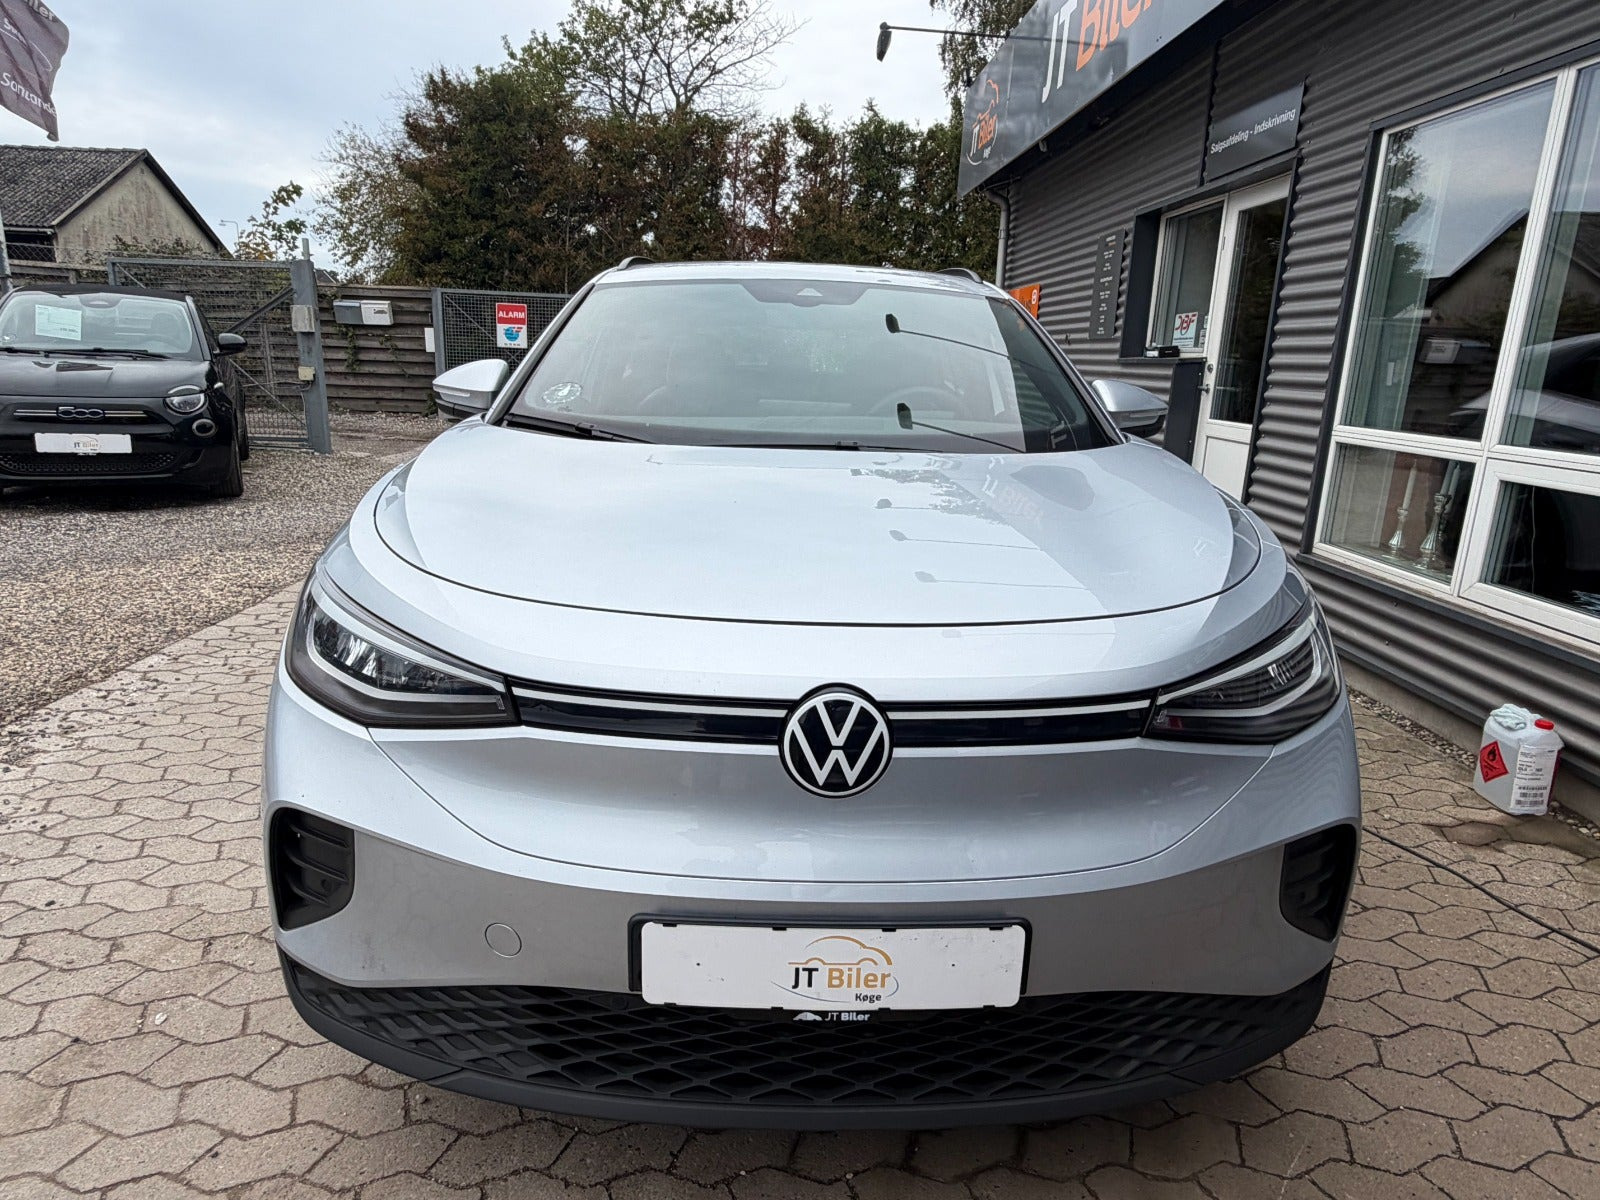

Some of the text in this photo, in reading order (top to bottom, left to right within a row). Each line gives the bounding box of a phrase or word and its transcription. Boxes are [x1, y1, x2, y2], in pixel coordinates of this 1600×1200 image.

[25, 0, 57, 21] iler
[1041, 0, 1152, 104] JT Bil
[1210, 130, 1250, 154] Salgsafdeling
[1254, 109, 1296, 135] Indskrivning
[498, 310, 526, 319] ALARM
[58, 406, 104, 418] 500
[784, 693, 890, 797] VW
[792, 967, 891, 989] JT Biler
[855, 992, 882, 1004] Køge
[824, 1012, 870, 1021] JT Biler
